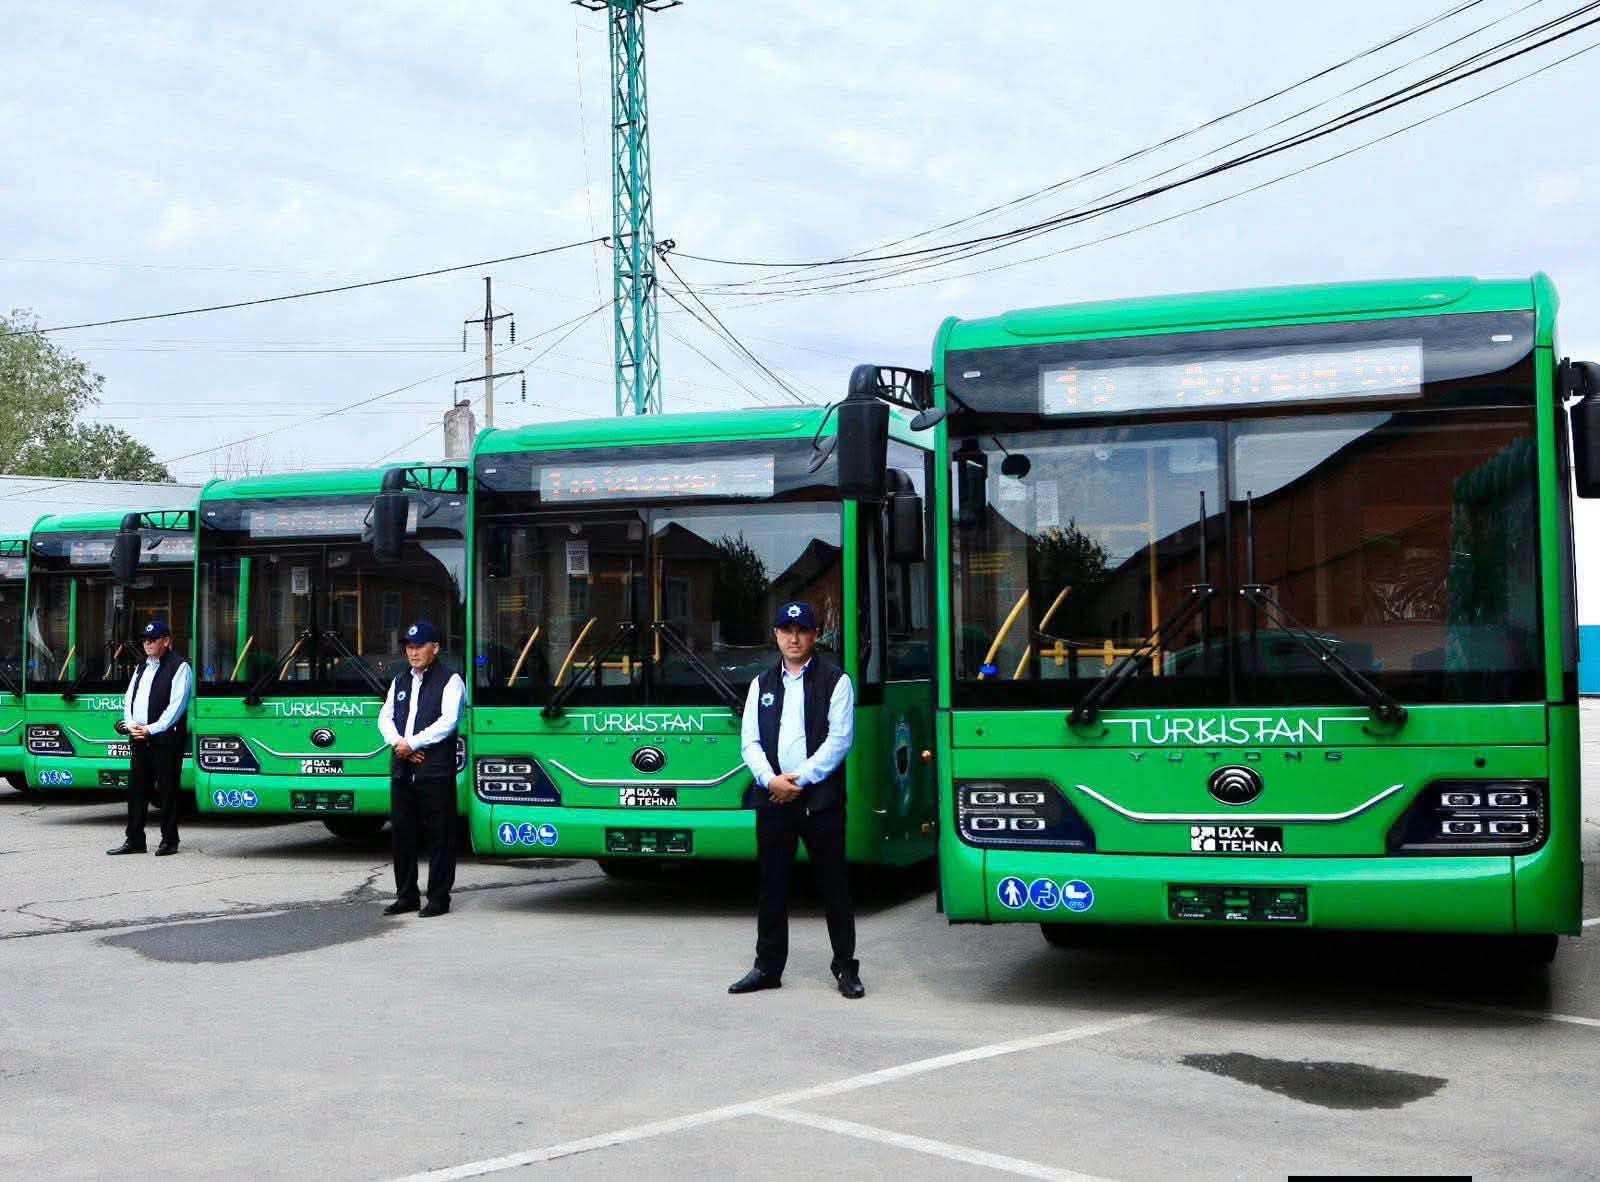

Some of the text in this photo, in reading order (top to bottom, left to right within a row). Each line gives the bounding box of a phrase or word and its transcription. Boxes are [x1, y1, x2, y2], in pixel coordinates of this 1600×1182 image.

[637, 797, 677, 806] TEHNA
[1218, 826, 1255, 838] QAZ
[1219, 840, 1283, 852] TEHNA
